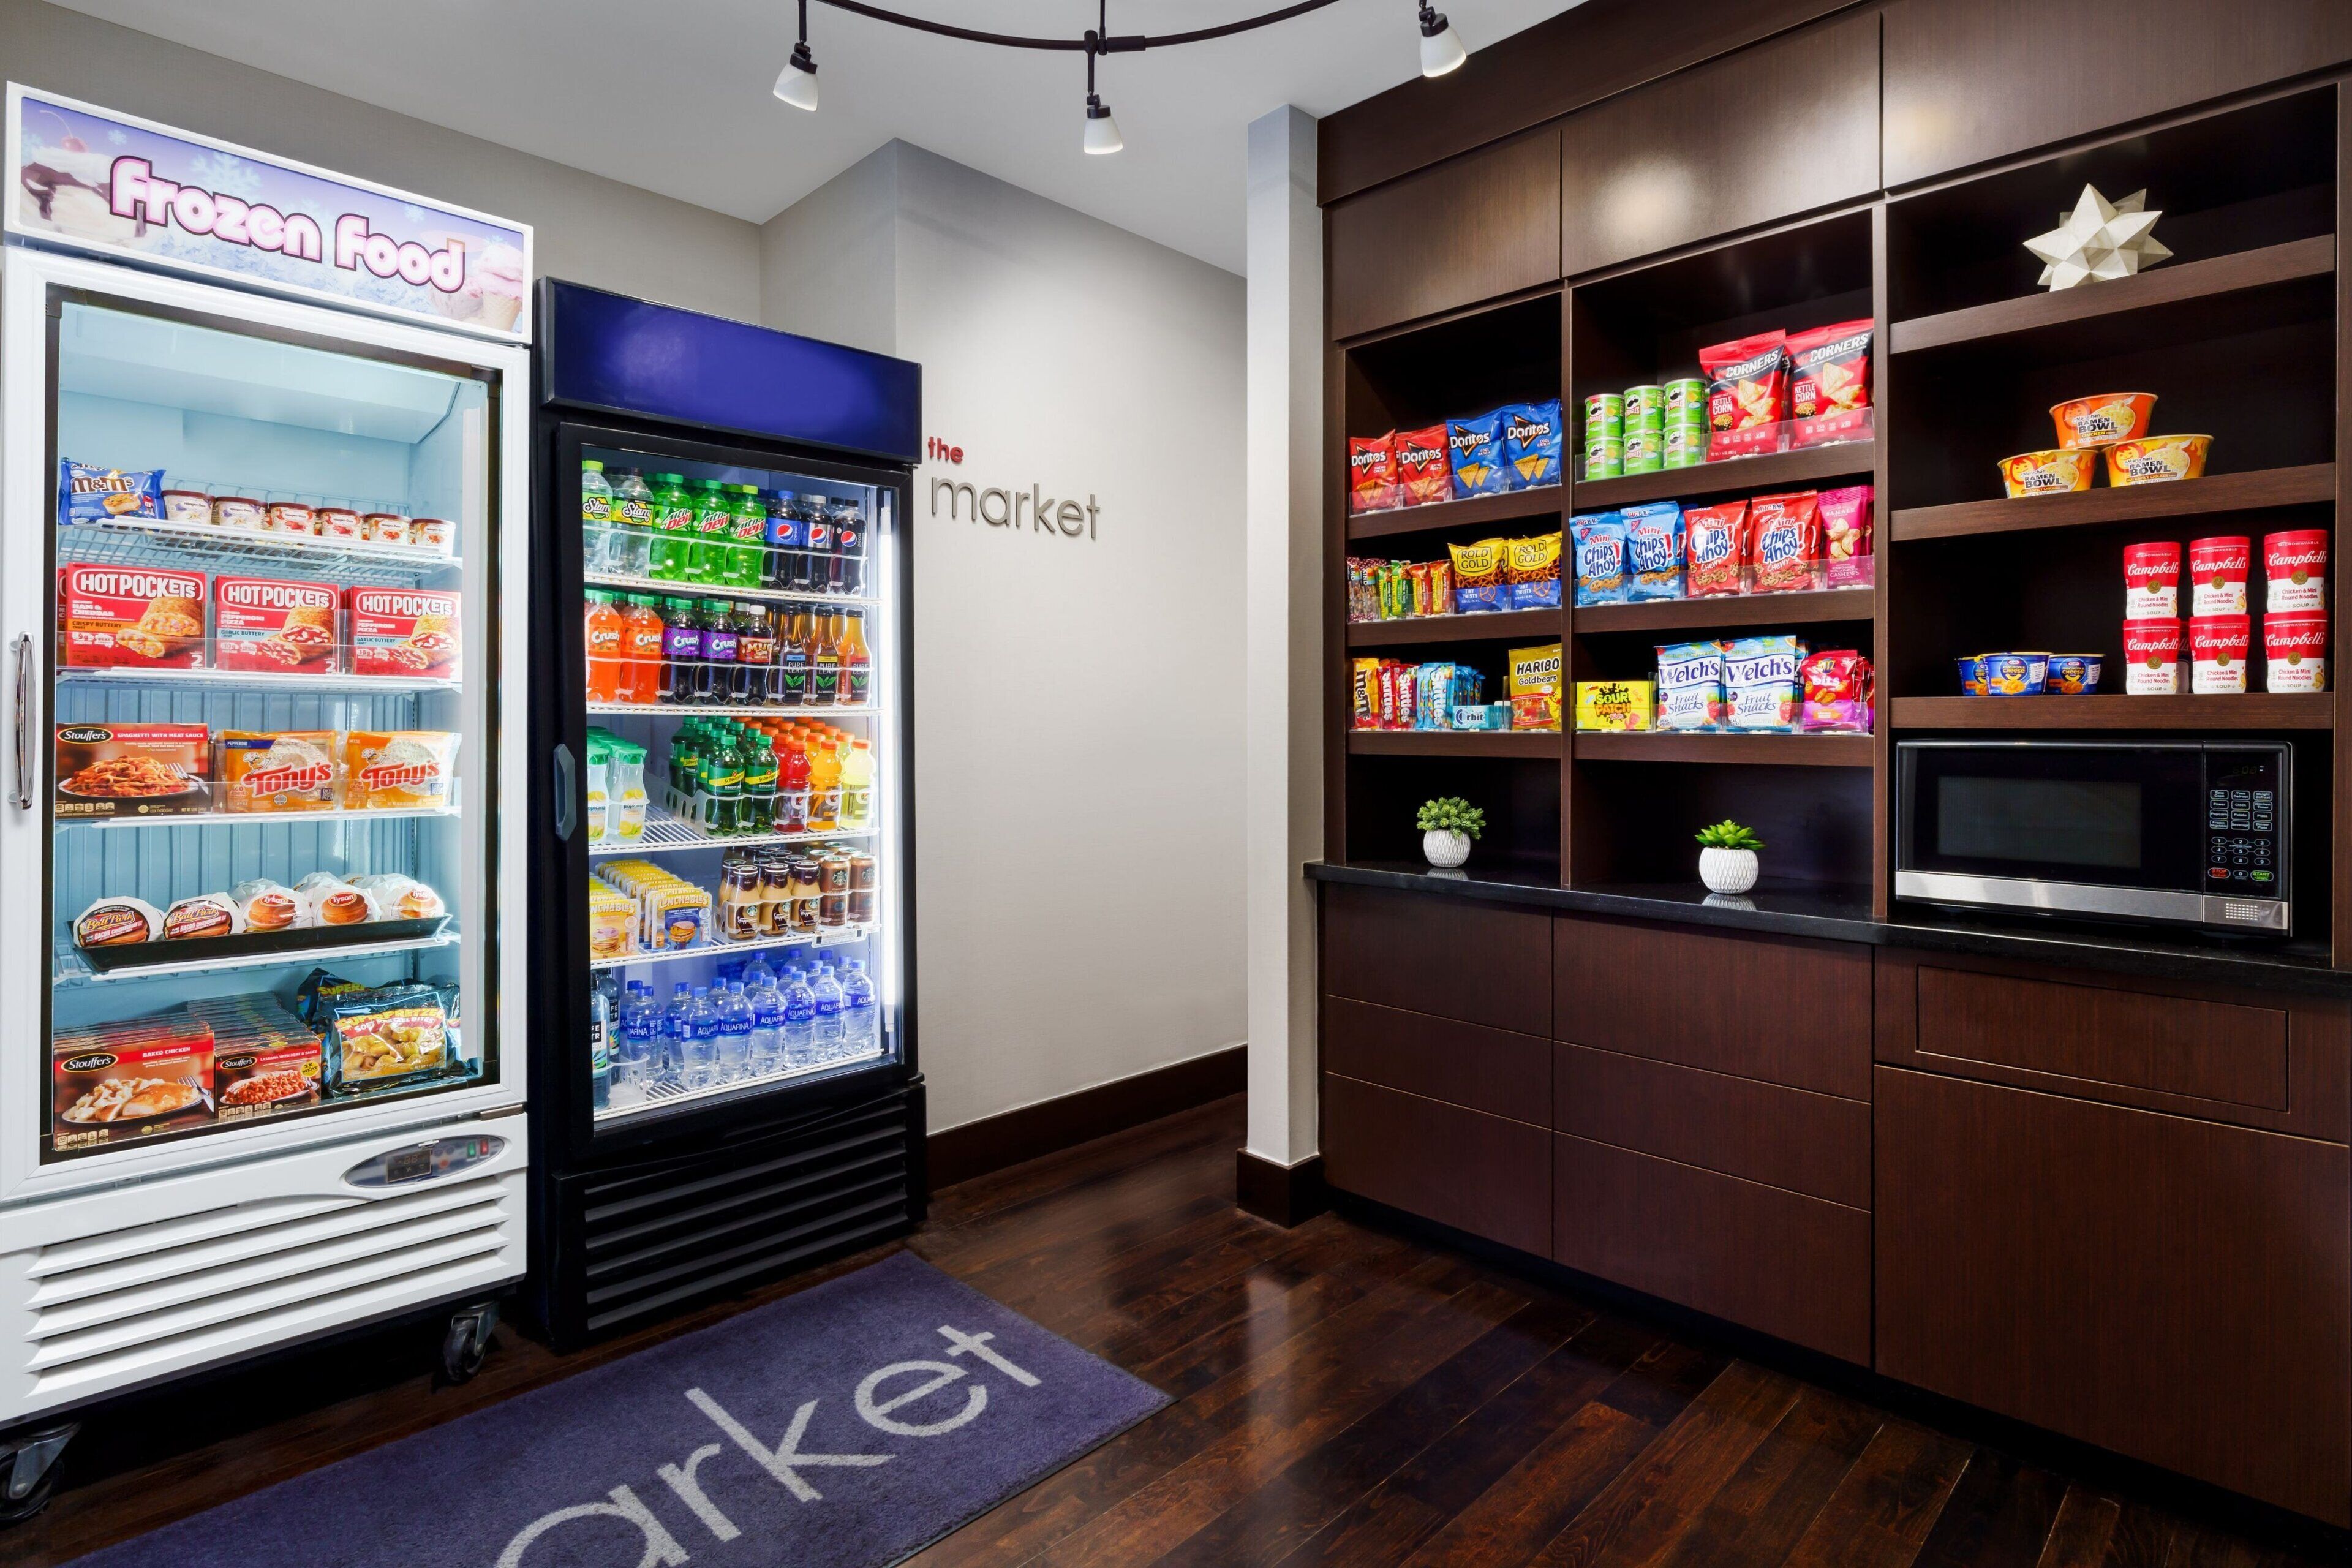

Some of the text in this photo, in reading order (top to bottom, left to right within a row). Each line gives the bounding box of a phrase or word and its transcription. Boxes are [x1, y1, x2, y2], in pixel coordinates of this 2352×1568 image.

[1810, 333, 1868, 363] CORNERS
[1725, 350, 1779, 378] CORNERS
[1795, 383, 1815, 394] KETTLE
[1712, 396, 1732, 407] KETTLE
[1795, 391, 1816, 403] CORN
[1713, 402, 1733, 415] CORN
[2078, 417, 2110, 426] RAMEN
[2078, 422, 2118, 434] BOWL
[1507, 422, 1550, 440] Doritos
[1450, 431, 1490, 450] Doritos
[928, 436, 964, 464] the
[1401, 447, 1442, 464] Doritos
[1351, 451, 1387, 467] Doritos
[2129, 460, 2163, 469] RAMEN
[2130, 465, 2171, 477] BOWL
[2026, 478, 2063, 488] BOWL
[932, 477, 1101, 539] market
[1697, 517, 1725, 528] Mini
[1769, 517, 1795, 530] Mini
[1638, 527, 1661, 537] Mini
[1589, 534, 1611, 545] Mini
[1762, 527, 1796, 551] Chips
[1461, 549, 1488, 559] ROLD
[1520, 542, 1545, 553] ROLD
[1635, 537, 1664, 559] Chips
[1518, 553, 1545, 564] GOLD
[1584, 545, 1613, 566] Chips
[2269, 550, 2326, 567] Campbell's
[1461, 559, 1489, 569] GOLD
[1701, 558, 1722, 571] CHEWY
[1767, 558, 1790, 572] CHEWY
[2128, 561, 2179, 576] Campbell's
[2192, 557, 2246, 573] Campbell's
[591, 630, 620, 643] Crush
[636, 633, 662, 646] Crush
[673, 635, 699, 647] Crush
[2195, 634, 2248, 649] Campbell's
[2266, 631, 2324, 647] Campbell's
[712, 639, 736, 652] Crush
[2127, 638, 2178, 653] Campbell's
[1517, 657, 1559, 675] HARIBO
[1659, 660, 1719, 684] Welch's
[1726, 658, 1792, 682] Welch's
[1518, 675, 1557, 685] Goldbears
[1382, 672, 1392, 721] Skittles
[1399, 673, 1412, 722] Skittles
[1431, 669, 1444, 725] Skittles
[1596, 692, 1629, 705] SOUR
[1675, 693, 1698, 704] Fruit
[1745, 692, 1770, 704] Fruit
[1595, 703, 1631, 716] PATCH
[1668, 701, 1704, 715] Snacks
[1737, 701, 1776, 715] Snacks
[64, 730, 107, 741] Stouffer's
[242, 761, 333, 796] Tony's
[360, 760, 440, 790] Tony's
[332, 894, 354, 905] Tyson
[658, 894, 709, 911] LUNCHABLES
[85, 911, 135, 931] Ball Park
[172, 911, 194, 922] Ball
[788, 1007, 815, 1018] AQUAFINA
[720, 1023, 750, 1032] AQUAFINA
[68, 1055, 111, 1069] Stouffer's
[492, 1324, 1043, 1568] arket
